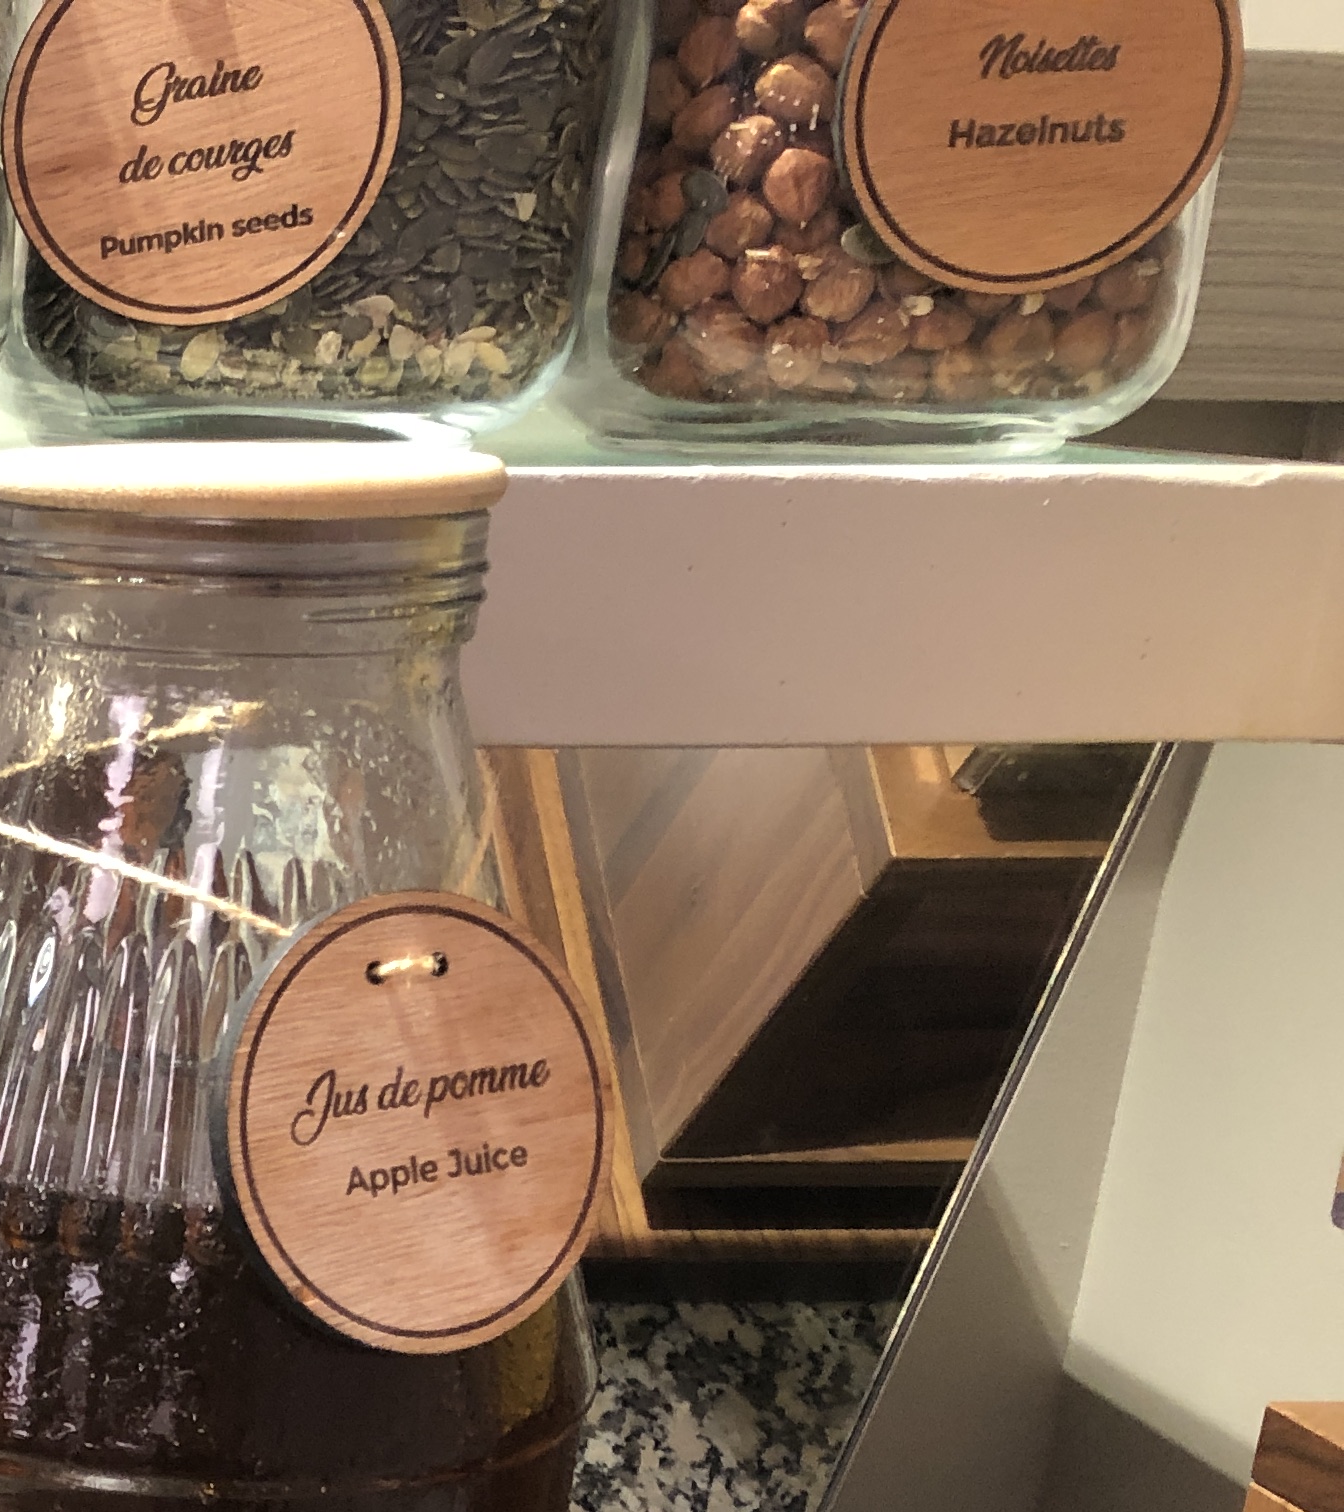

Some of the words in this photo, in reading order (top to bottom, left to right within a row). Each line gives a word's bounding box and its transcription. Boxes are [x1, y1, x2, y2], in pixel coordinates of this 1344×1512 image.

[979, 32, 1121, 80] Noisettes
[130, 59, 264, 127] Graine
[118, 144, 165, 184] de
[168, 128, 297, 182] courges
[948, 113, 1127, 149] Hazelnuts
[100, 218, 224, 260] Pumpkin
[231, 203, 314, 239] seeds
[290, 1069, 369, 1146] Jus
[377, 1066, 423, 1112] de
[424, 1057, 552, 1119] pomme
[345, 1155, 439, 1198] Apple
[446, 1142, 529, 1180] Juice
